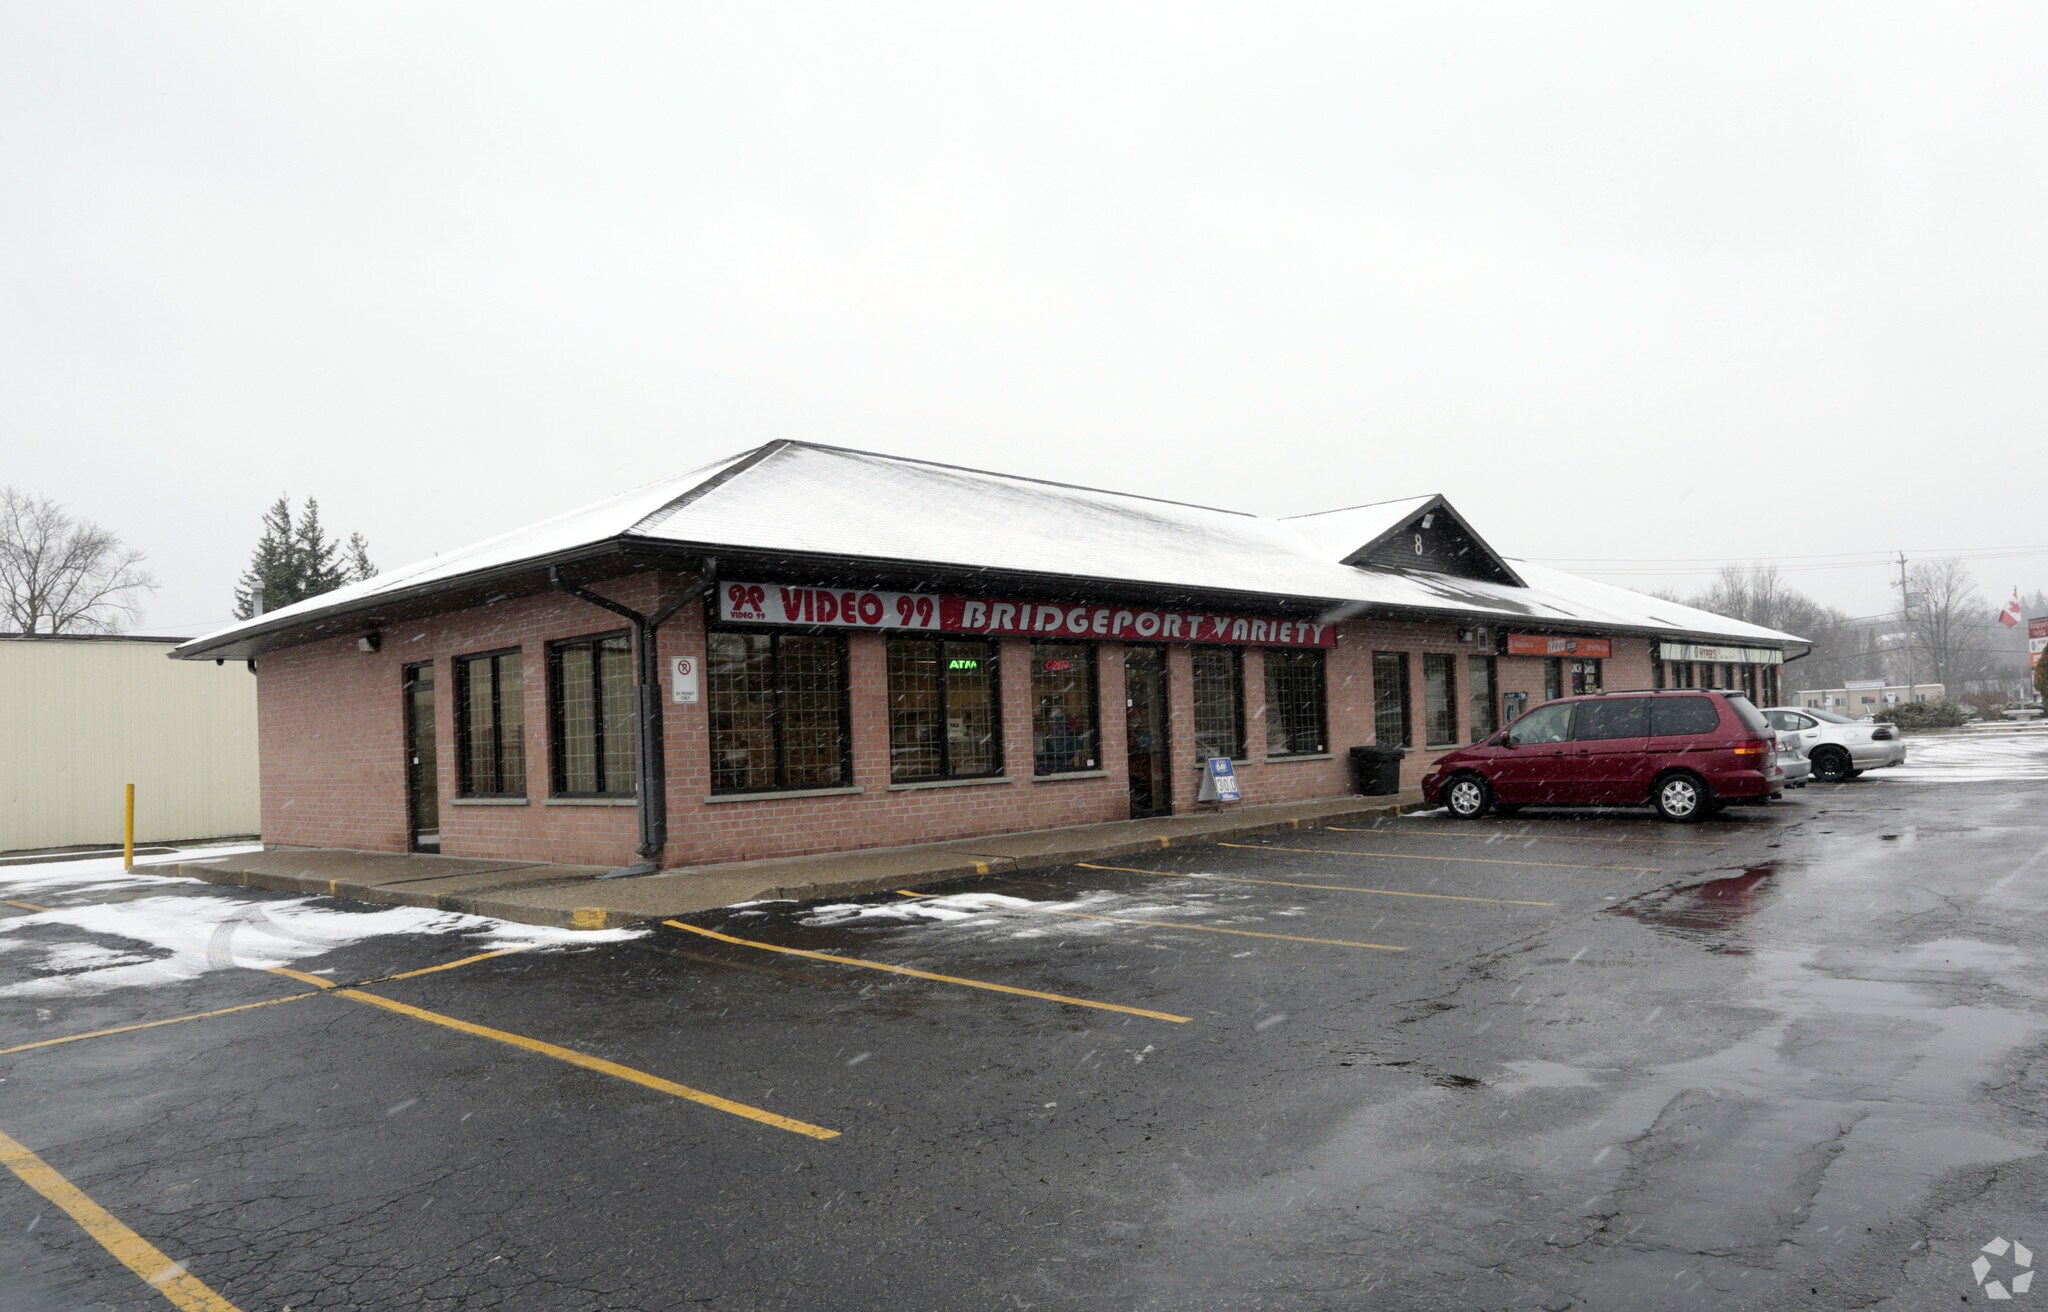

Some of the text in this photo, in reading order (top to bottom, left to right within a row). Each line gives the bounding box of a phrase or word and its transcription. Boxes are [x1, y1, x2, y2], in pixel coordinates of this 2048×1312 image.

[1414, 533, 1423, 556] 8
[730, 611, 766, 620] VIDEO 99
[780, 587, 934, 627] VIDEO 99
[961, 600, 1326, 644] BRIDGEPORT VARIETY
[949, 660, 977, 669] ATM
[1045, 659, 1071, 671] OPEN
